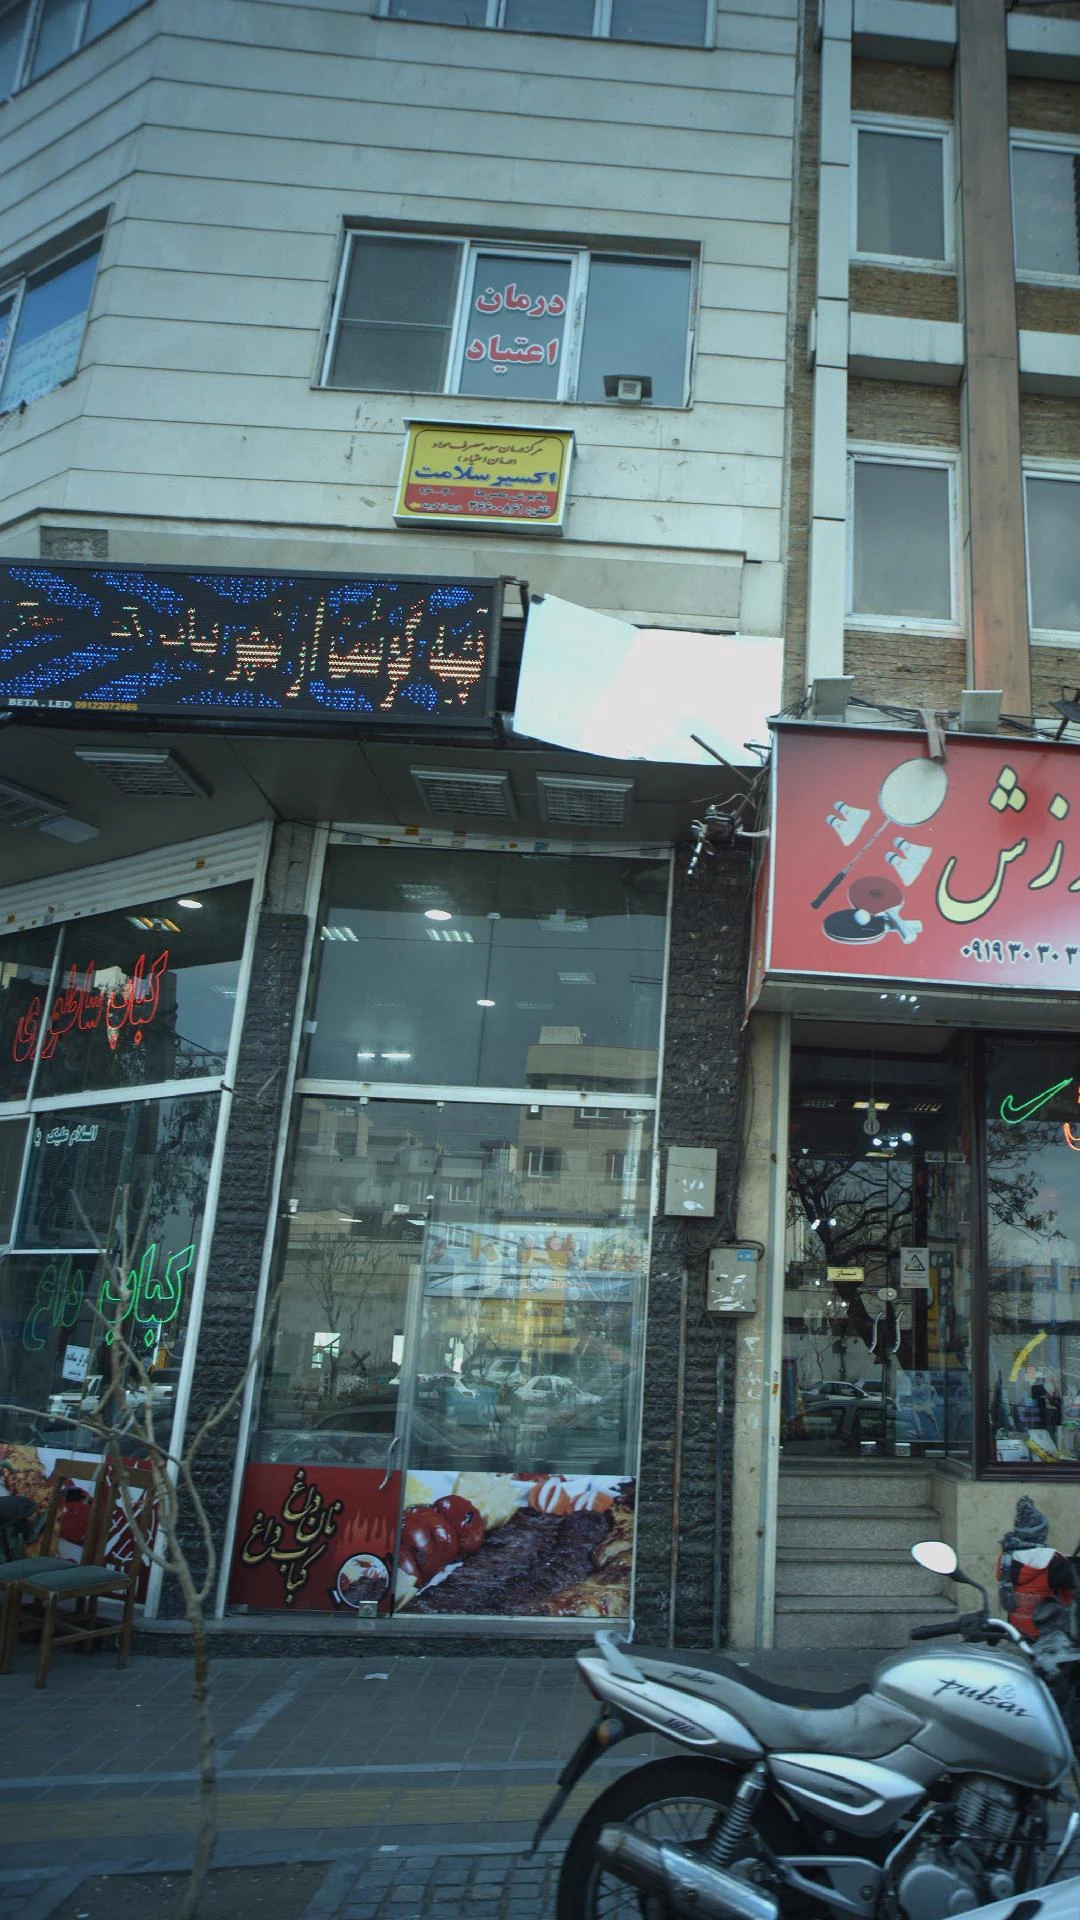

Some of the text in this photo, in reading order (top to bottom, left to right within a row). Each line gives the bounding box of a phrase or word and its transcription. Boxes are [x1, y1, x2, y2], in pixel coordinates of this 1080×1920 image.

[475, 283, 566, 316] درمان
[465, 334, 559, 373] اعتیاد
[414, 464, 557, 487] اکسیر سلامت
[105, 950, 169, 1050] کباب
[68, 1124, 98, 1147] السلام
[22, 1244, 196, 1350] کباب داغ
[282, 1469, 342, 1543] نان داغ
[242, 1511, 328, 1603] کباب داغ
